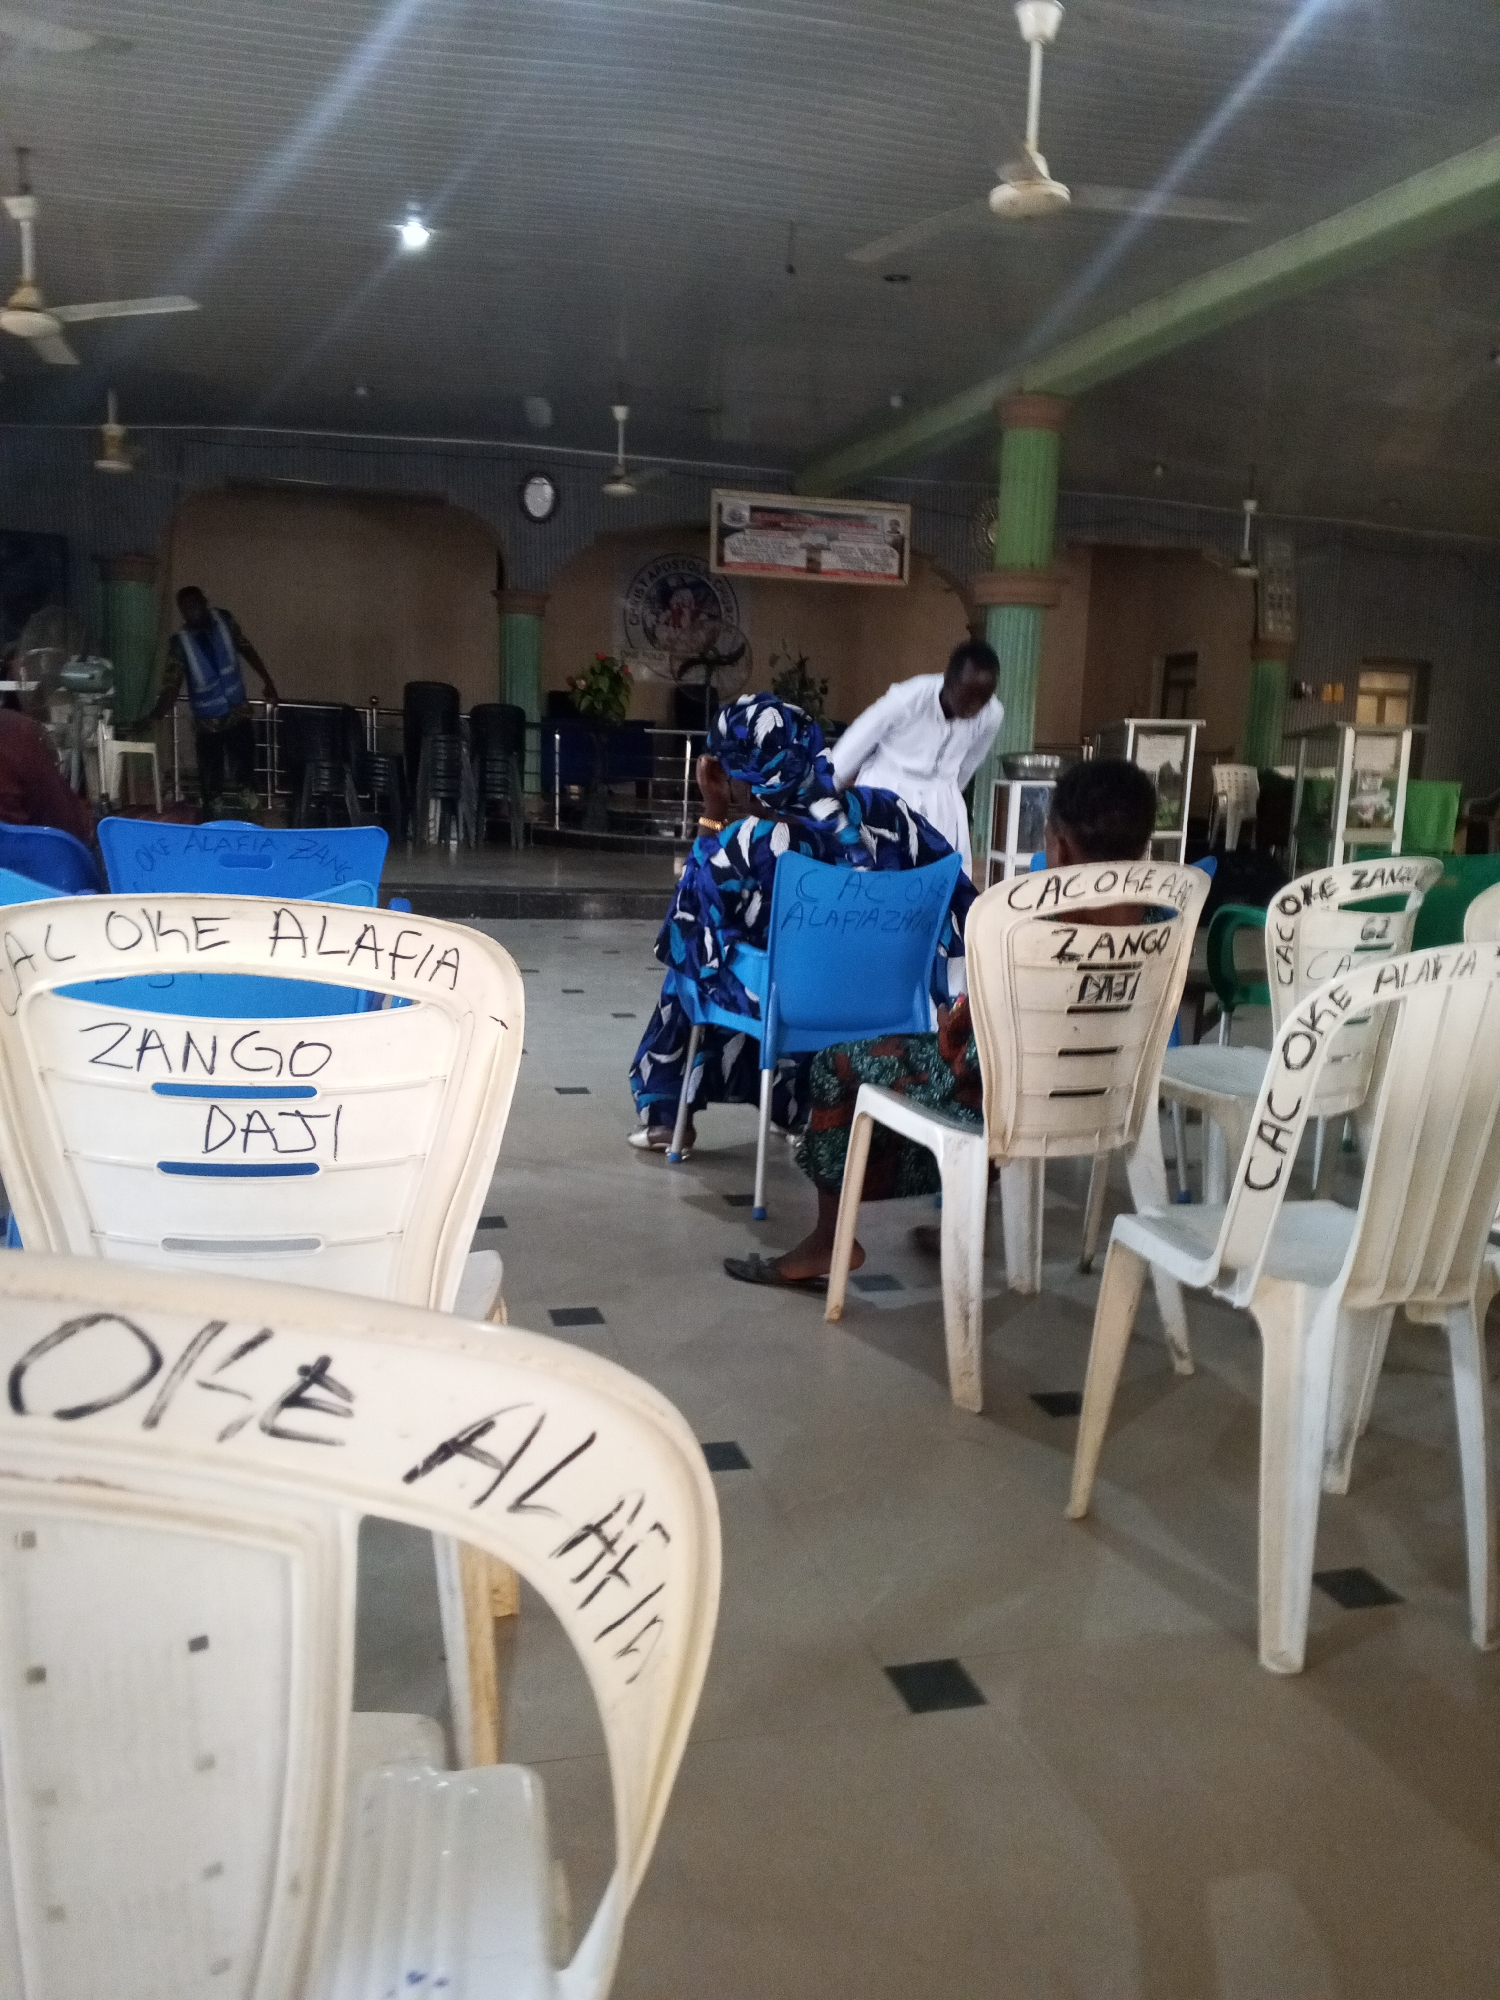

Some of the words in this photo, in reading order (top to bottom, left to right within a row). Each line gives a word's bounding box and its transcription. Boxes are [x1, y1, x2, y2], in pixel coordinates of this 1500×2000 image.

[183, 829, 277, 854] ALAFIA
[1007, 874, 1086, 911] CAC
[104, 907, 231, 955] OKE
[269, 908, 462, 991] ALAFIA
[1051, 924, 1172, 964] ZANGO
[1275, 921, 1295, 987] CAC
[79, 1022, 333, 1078] ZANGO
[1244, 1088, 1302, 1192] CAC
[1281, 984, 1353, 1071] OKE
[202, 1103, 343, 1162] DAJI
[7, 1312, 357, 1446] OKE
[402, 1402, 671, 1686] ALAFIA
